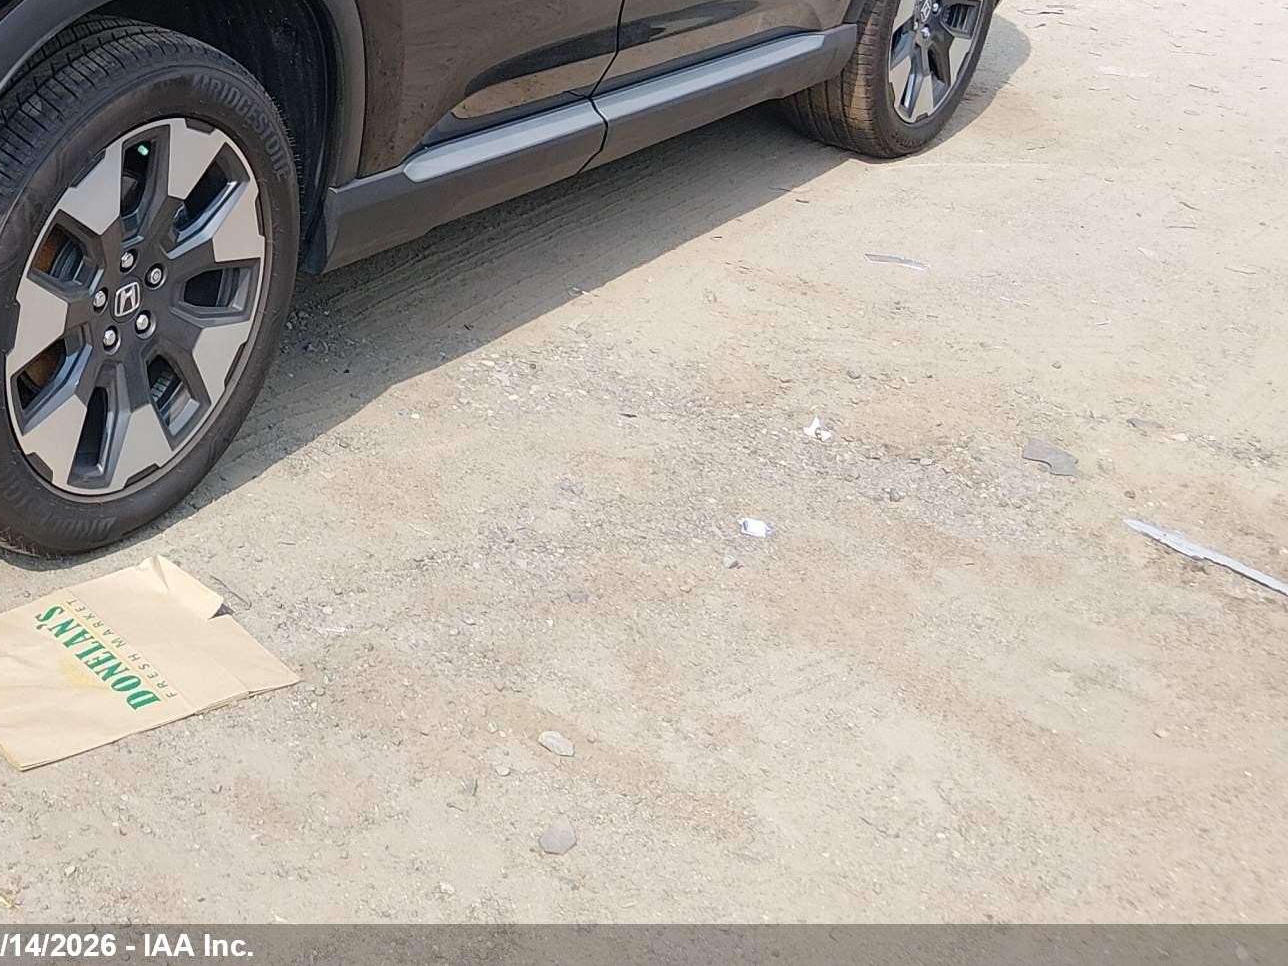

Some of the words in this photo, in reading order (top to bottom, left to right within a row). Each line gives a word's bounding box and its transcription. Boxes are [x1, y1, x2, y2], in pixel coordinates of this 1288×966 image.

[67, 599, 126, 648] MARKET
[34, 605, 161, 710] DONELAN'S
[128, 653, 178, 698] FRESH
